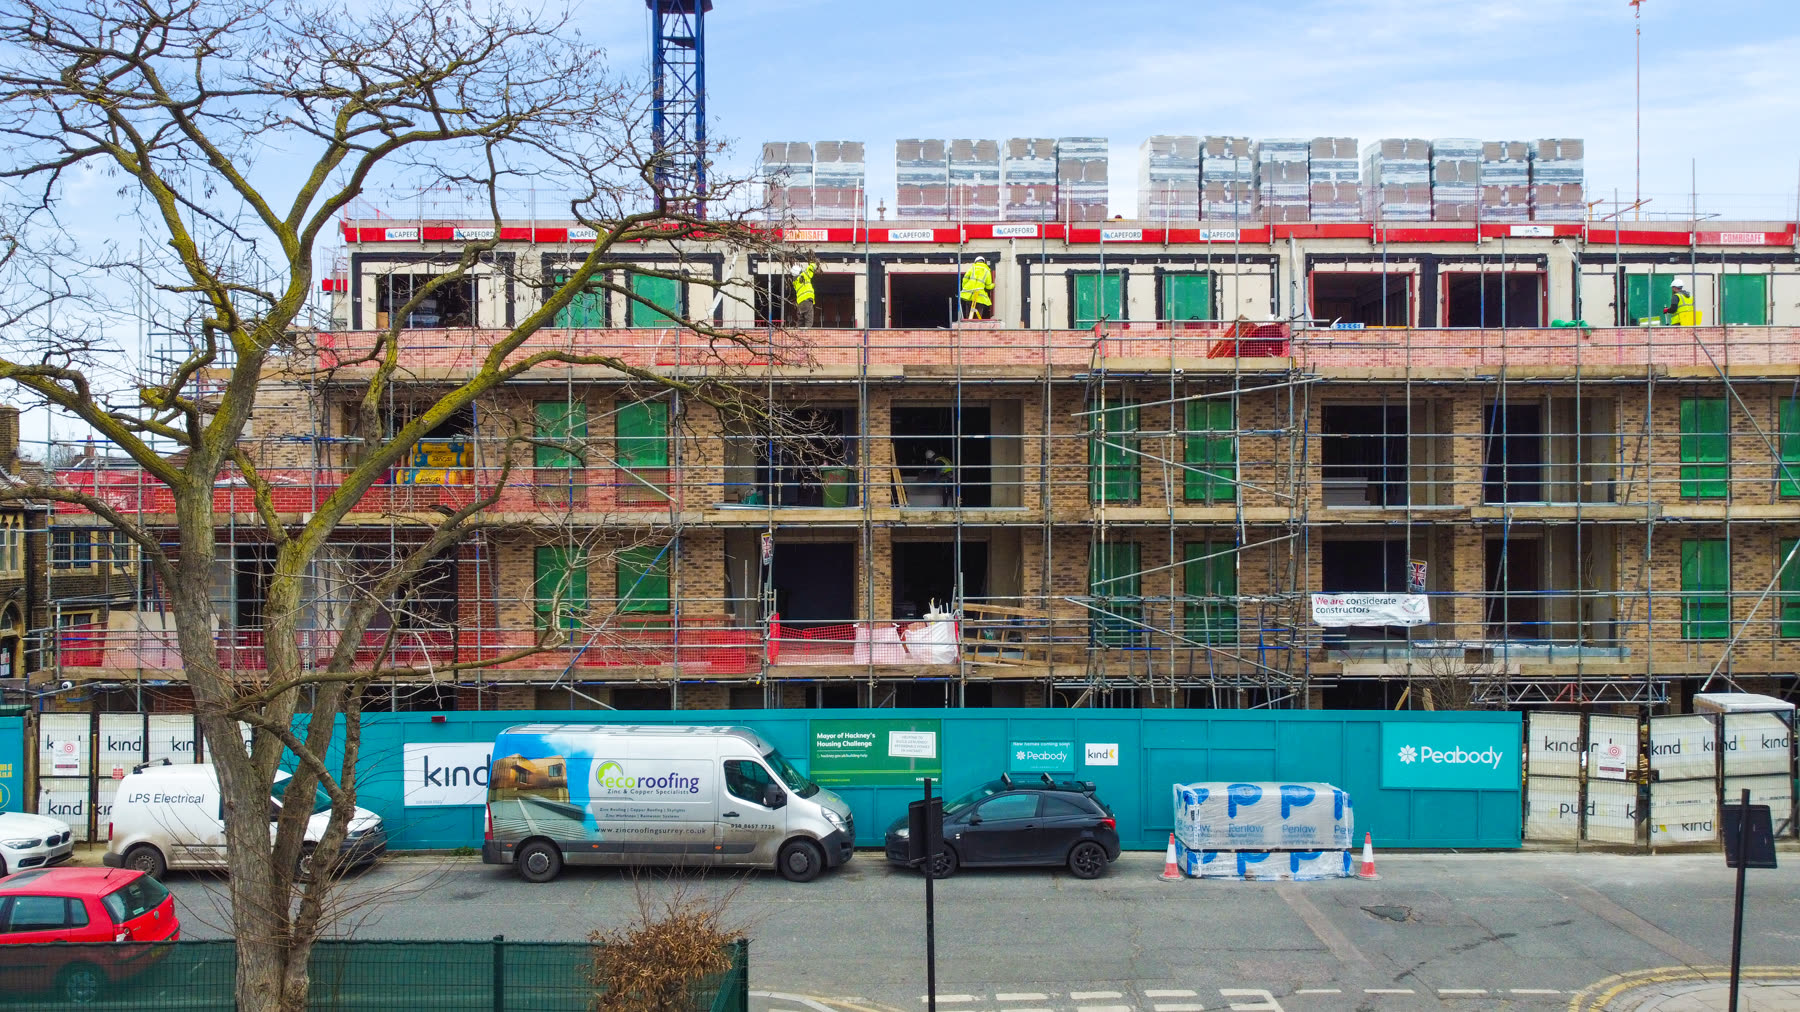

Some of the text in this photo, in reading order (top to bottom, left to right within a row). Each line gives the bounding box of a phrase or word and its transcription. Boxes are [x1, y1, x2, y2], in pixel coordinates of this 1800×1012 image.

[1722, 234, 1762, 242] COMBISAFE
[108, 736, 142, 752] kind
[1651, 738, 1680, 756] kind
[1762, 732, 1789, 749] kind
[1026, 750, 1068, 762] Peabody
[1088, 748, 1108, 759] kind
[1420, 746, 1503, 770] Peabody
[424, 754, 491, 788] kind
[128, 793, 205, 804] LPS Electrical
[48, 798, 82, 816] kind
[594, 827, 707, 836] www.zincroofingsurrey.co.uk
[1282, 824, 1316, 834] Penlaw
